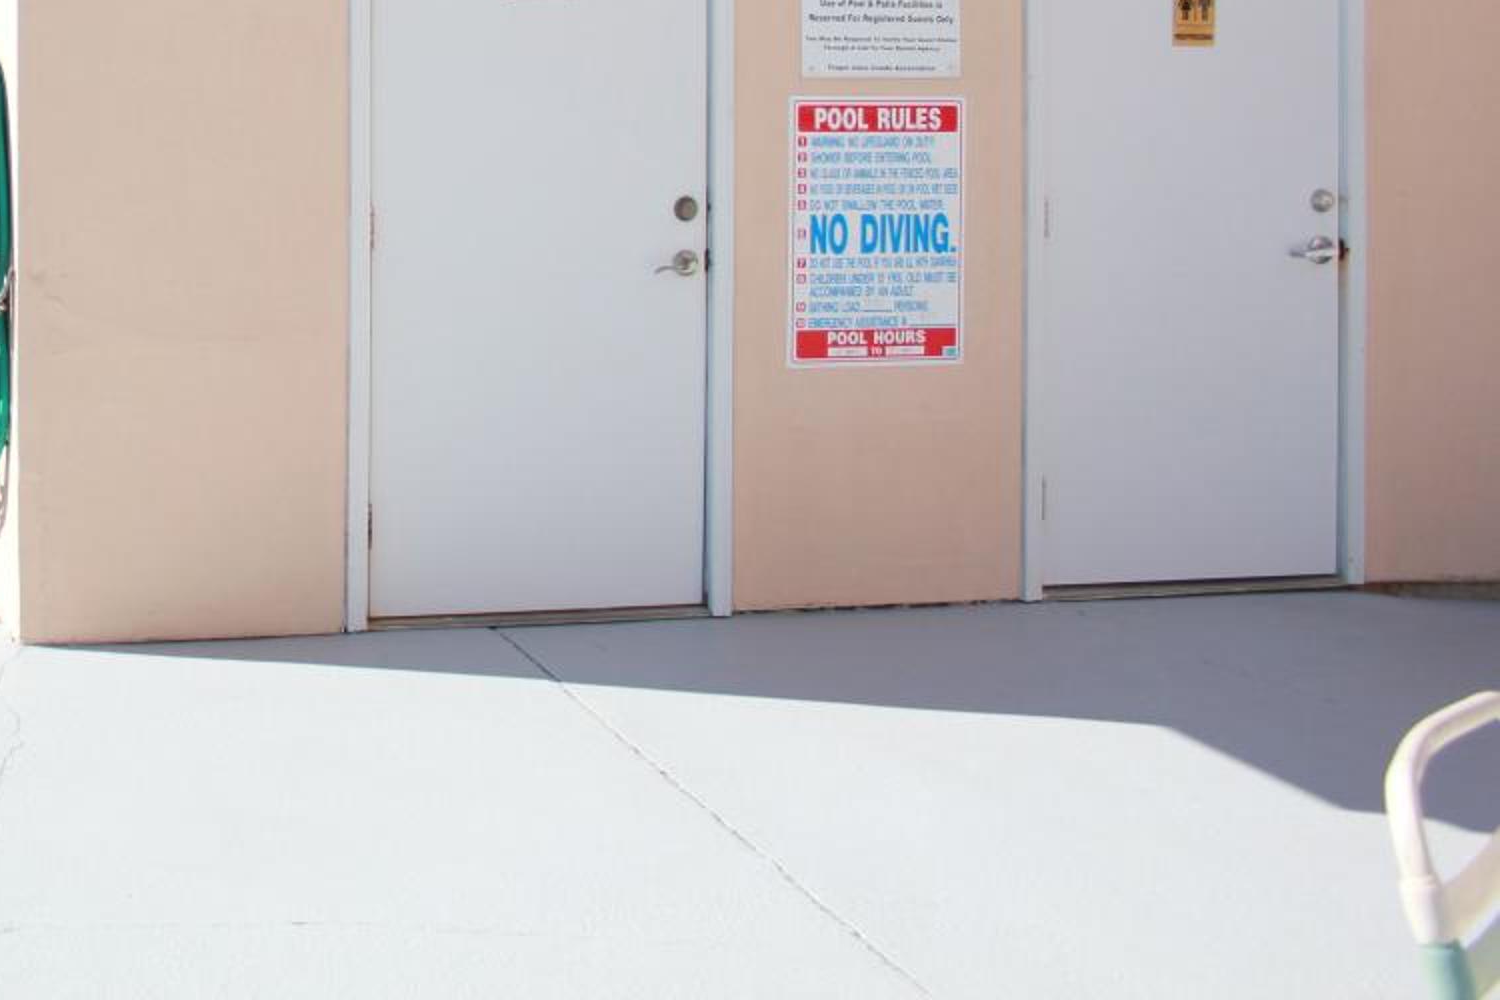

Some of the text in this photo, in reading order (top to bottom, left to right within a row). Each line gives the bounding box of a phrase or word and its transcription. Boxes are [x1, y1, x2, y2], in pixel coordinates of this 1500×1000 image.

[820, 0, 835, 8] Use
[838, 0, 846, 8] of
[848, 0, 865, 8] Pool
[876, 0, 895, 8] Patio
[898, 0, 933, 8] Facilities
[809, 13, 954, 24] Reserved For Registered Guests Only
[813, 107, 942, 130] POOL RULES
[810, 213, 956, 254] NO DIVING.
[828, 330, 926, 344] POOL HOURS
[871, 346, 883, 355] TO
